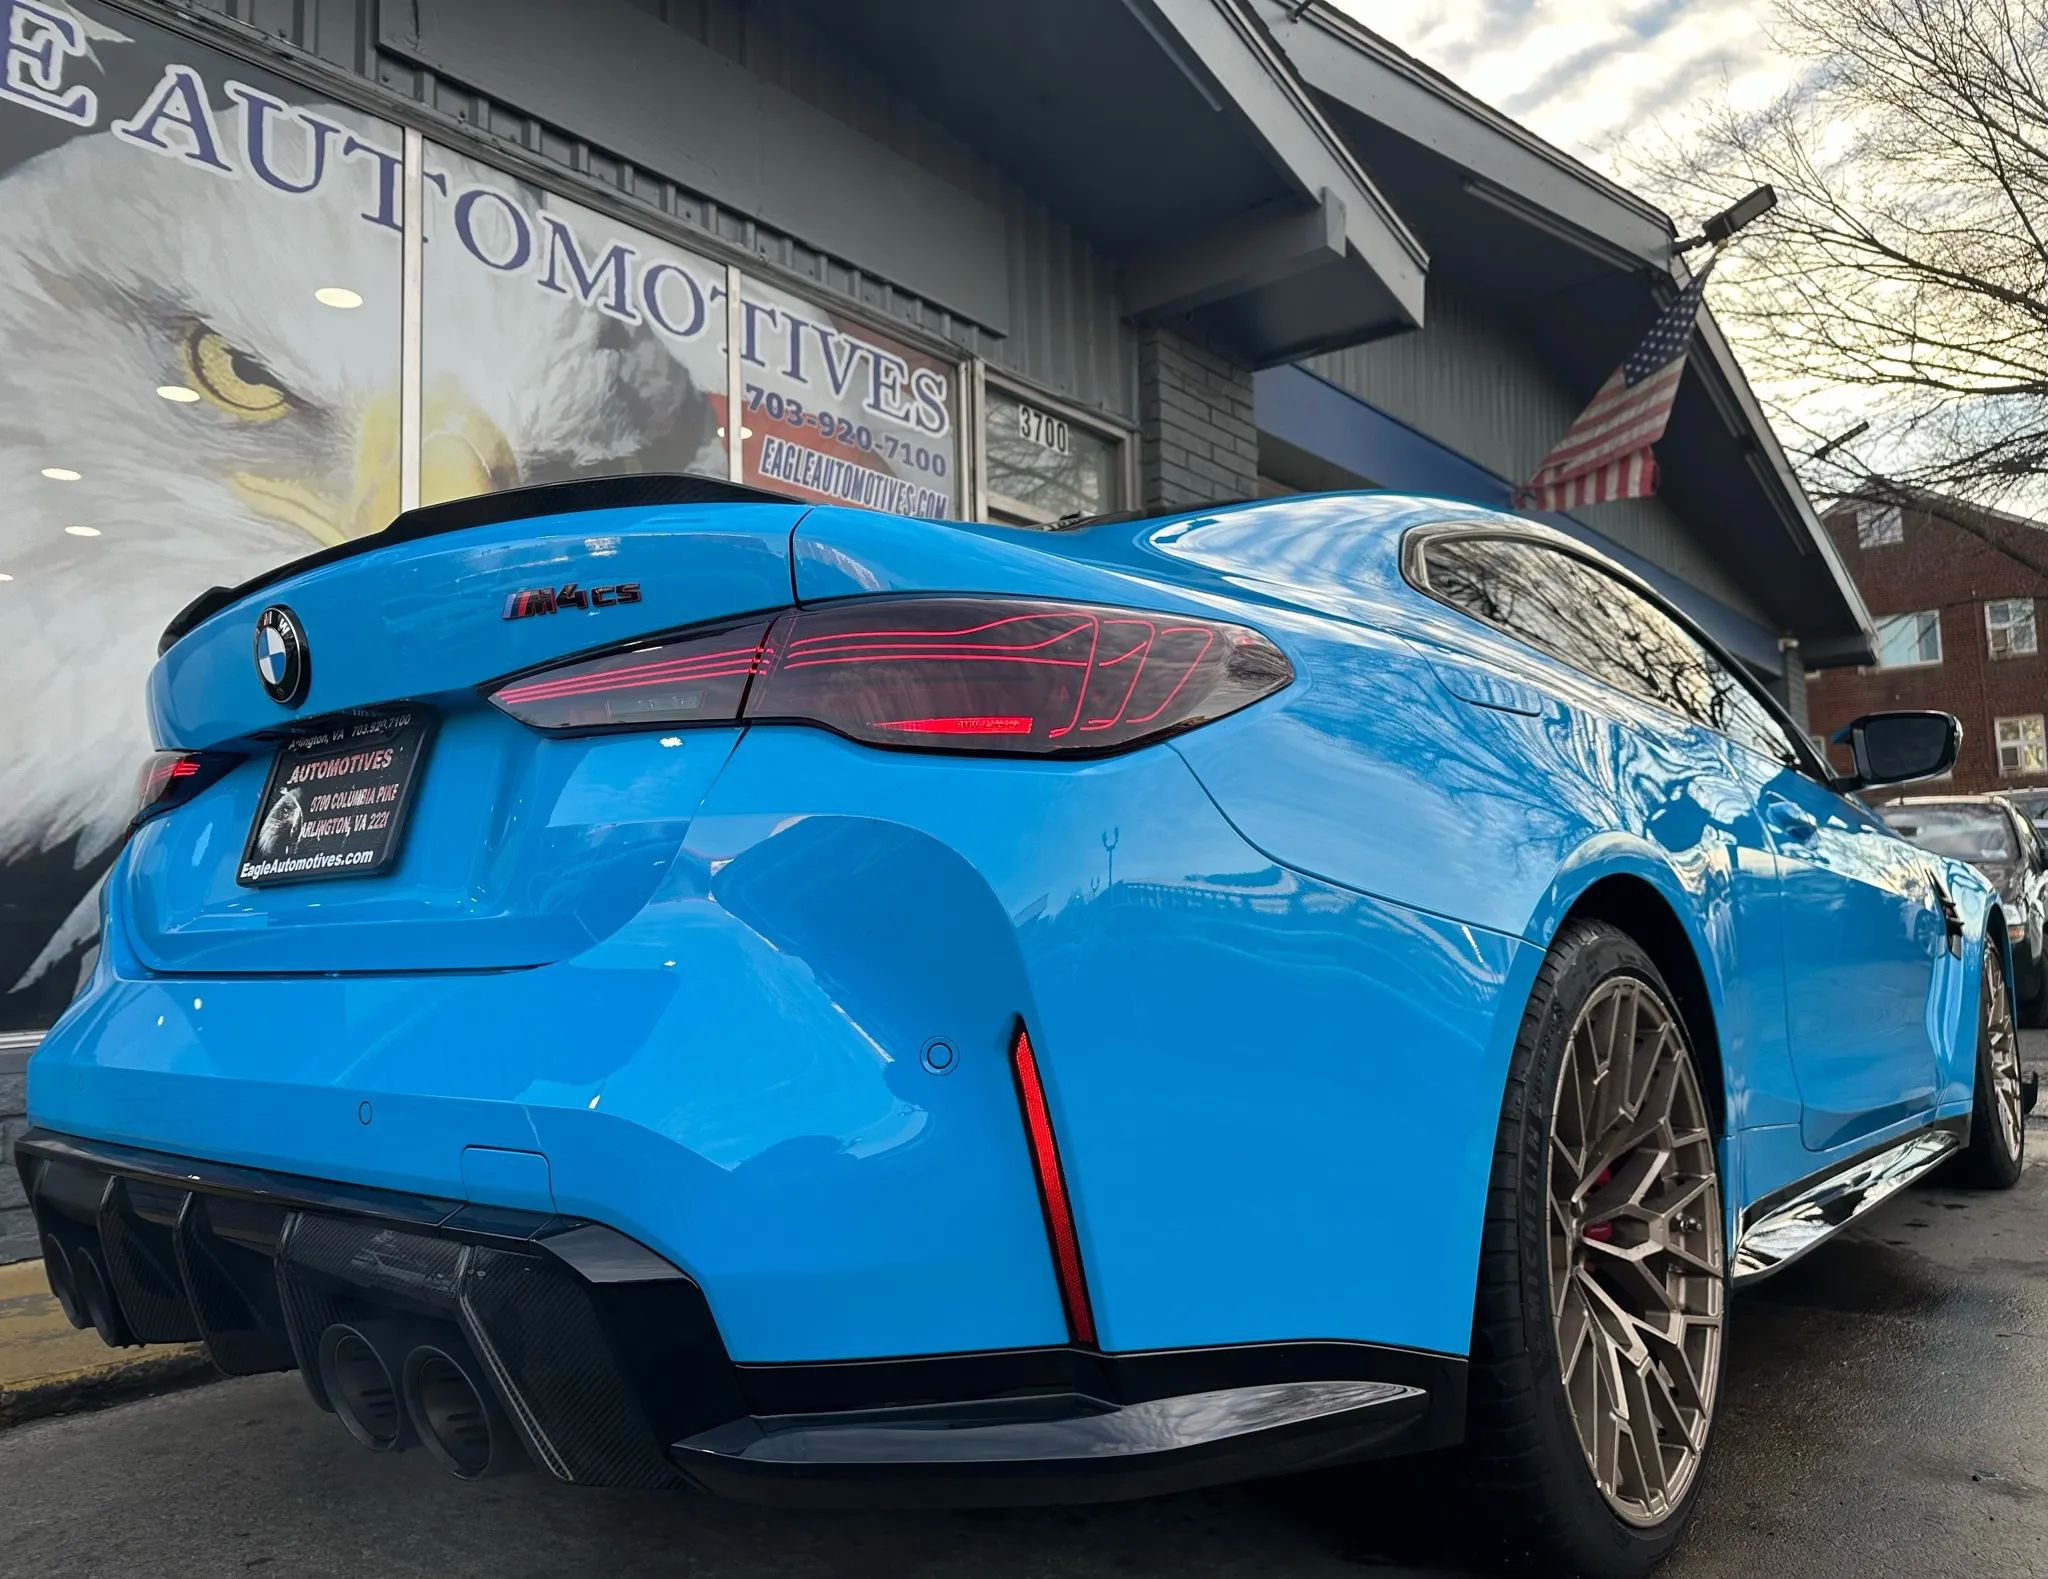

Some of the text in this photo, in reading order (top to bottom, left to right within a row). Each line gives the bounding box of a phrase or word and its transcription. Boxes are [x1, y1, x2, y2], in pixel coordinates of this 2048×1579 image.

[117, 72, 946, 432] AUTOMOTIVES
[745, 382, 946, 478] 703-920-7100
[1020, 405, 1066, 453] 3700
[759, 435, 949, 521] EAGLEAUTOMOTIVES.COM
[591, 583, 642, 607] CS
[332, 728, 344, 741] VA
[286, 748, 394, 785] AUTOMOTIVES
[330, 787, 375, 810] COLUMBIA
[375, 783, 399, 803] PIKE
[353, 813, 368, 832] VA
[240, 850, 374, 879] EagleAutomotives.com
